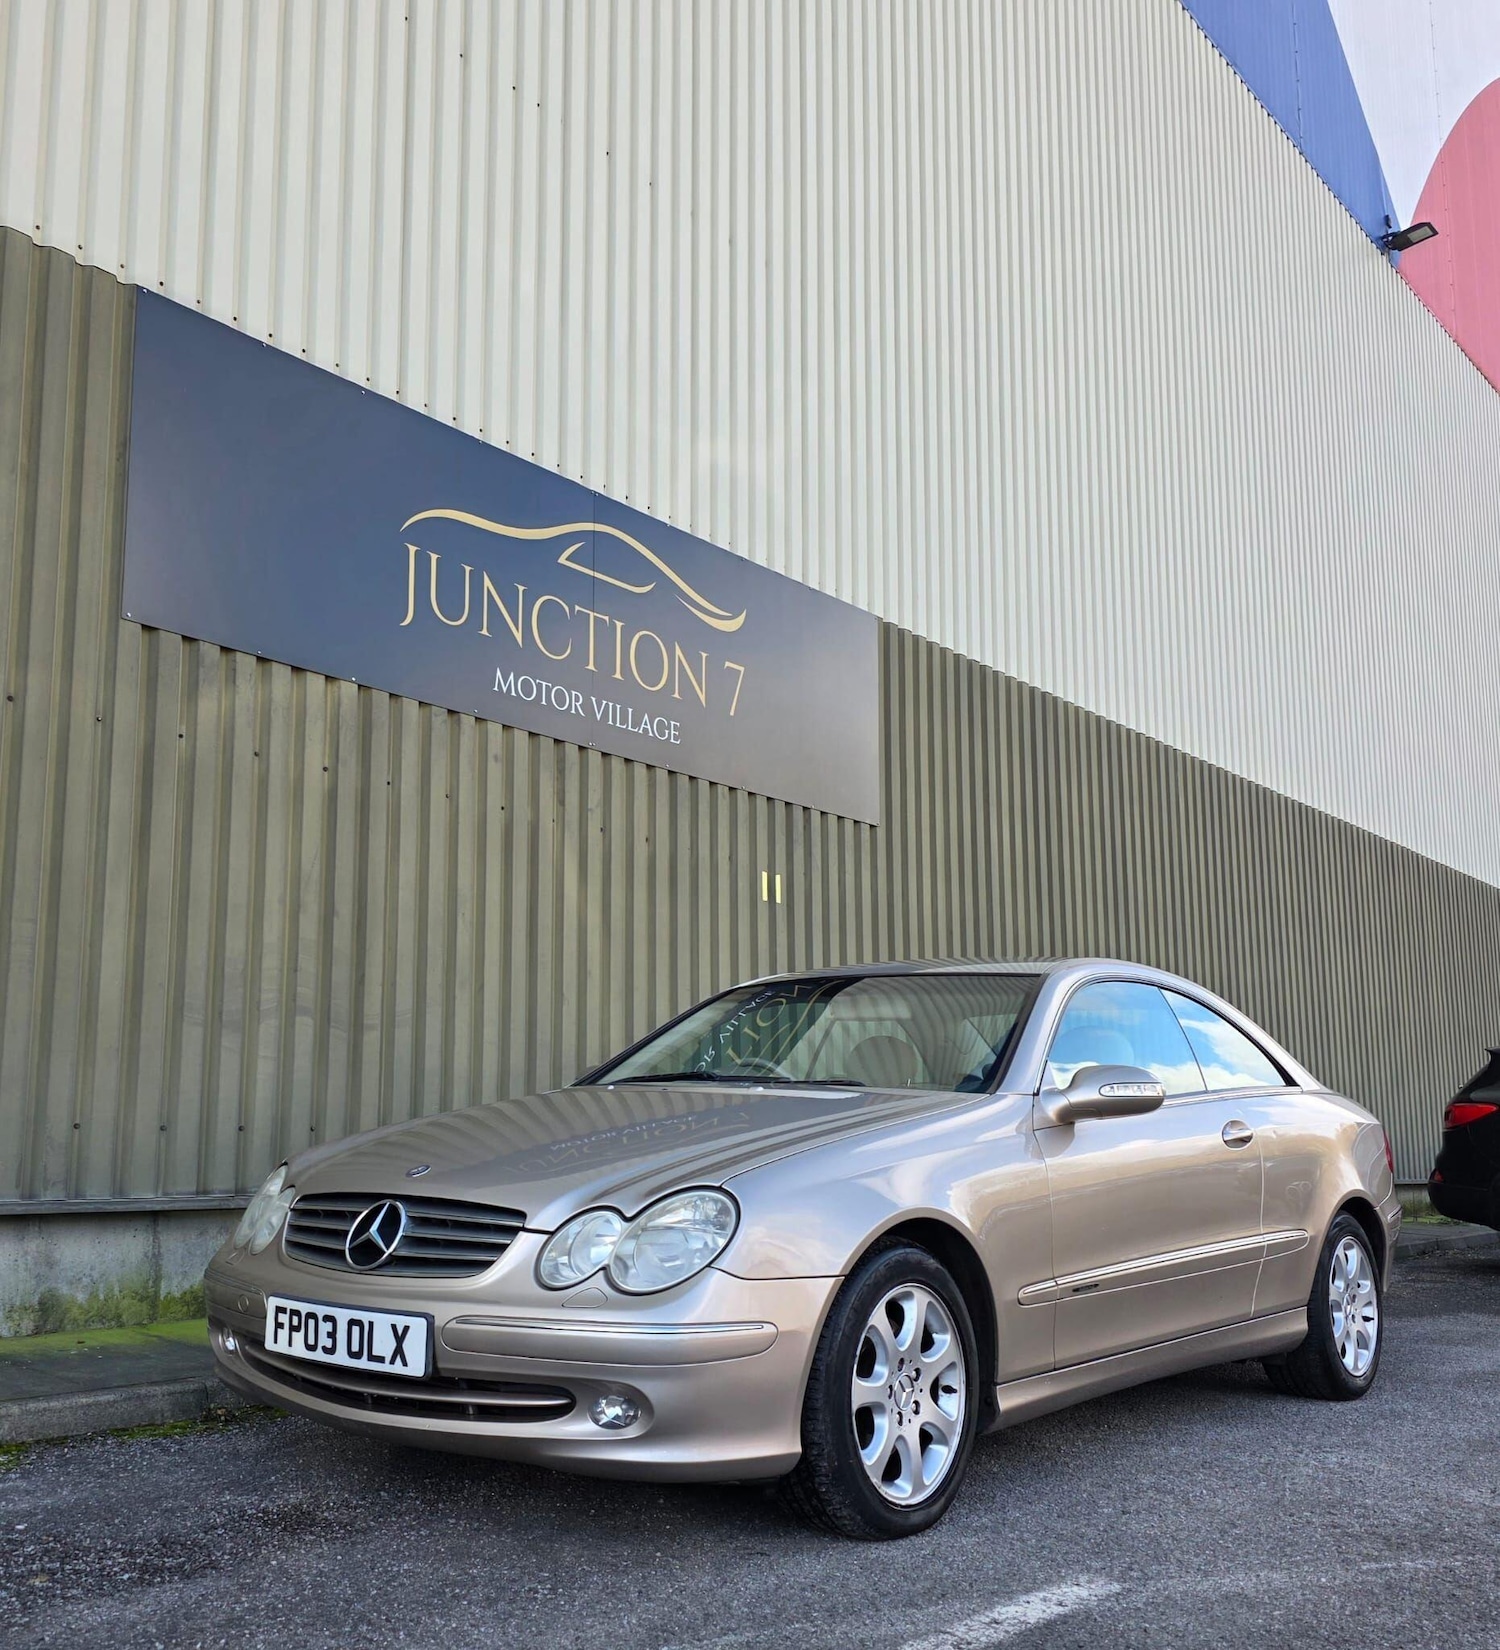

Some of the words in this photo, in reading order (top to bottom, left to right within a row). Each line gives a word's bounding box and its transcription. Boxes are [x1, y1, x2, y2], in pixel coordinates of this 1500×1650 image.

[399, 542, 709, 708] JUNCTION
[723, 660, 746, 716] 7
[492, 667, 586, 718] MOTOR
[590, 696, 681, 744] VILLAGE
[273, 1305, 338, 1356] FP03
[346, 1318, 411, 1368] OLX
